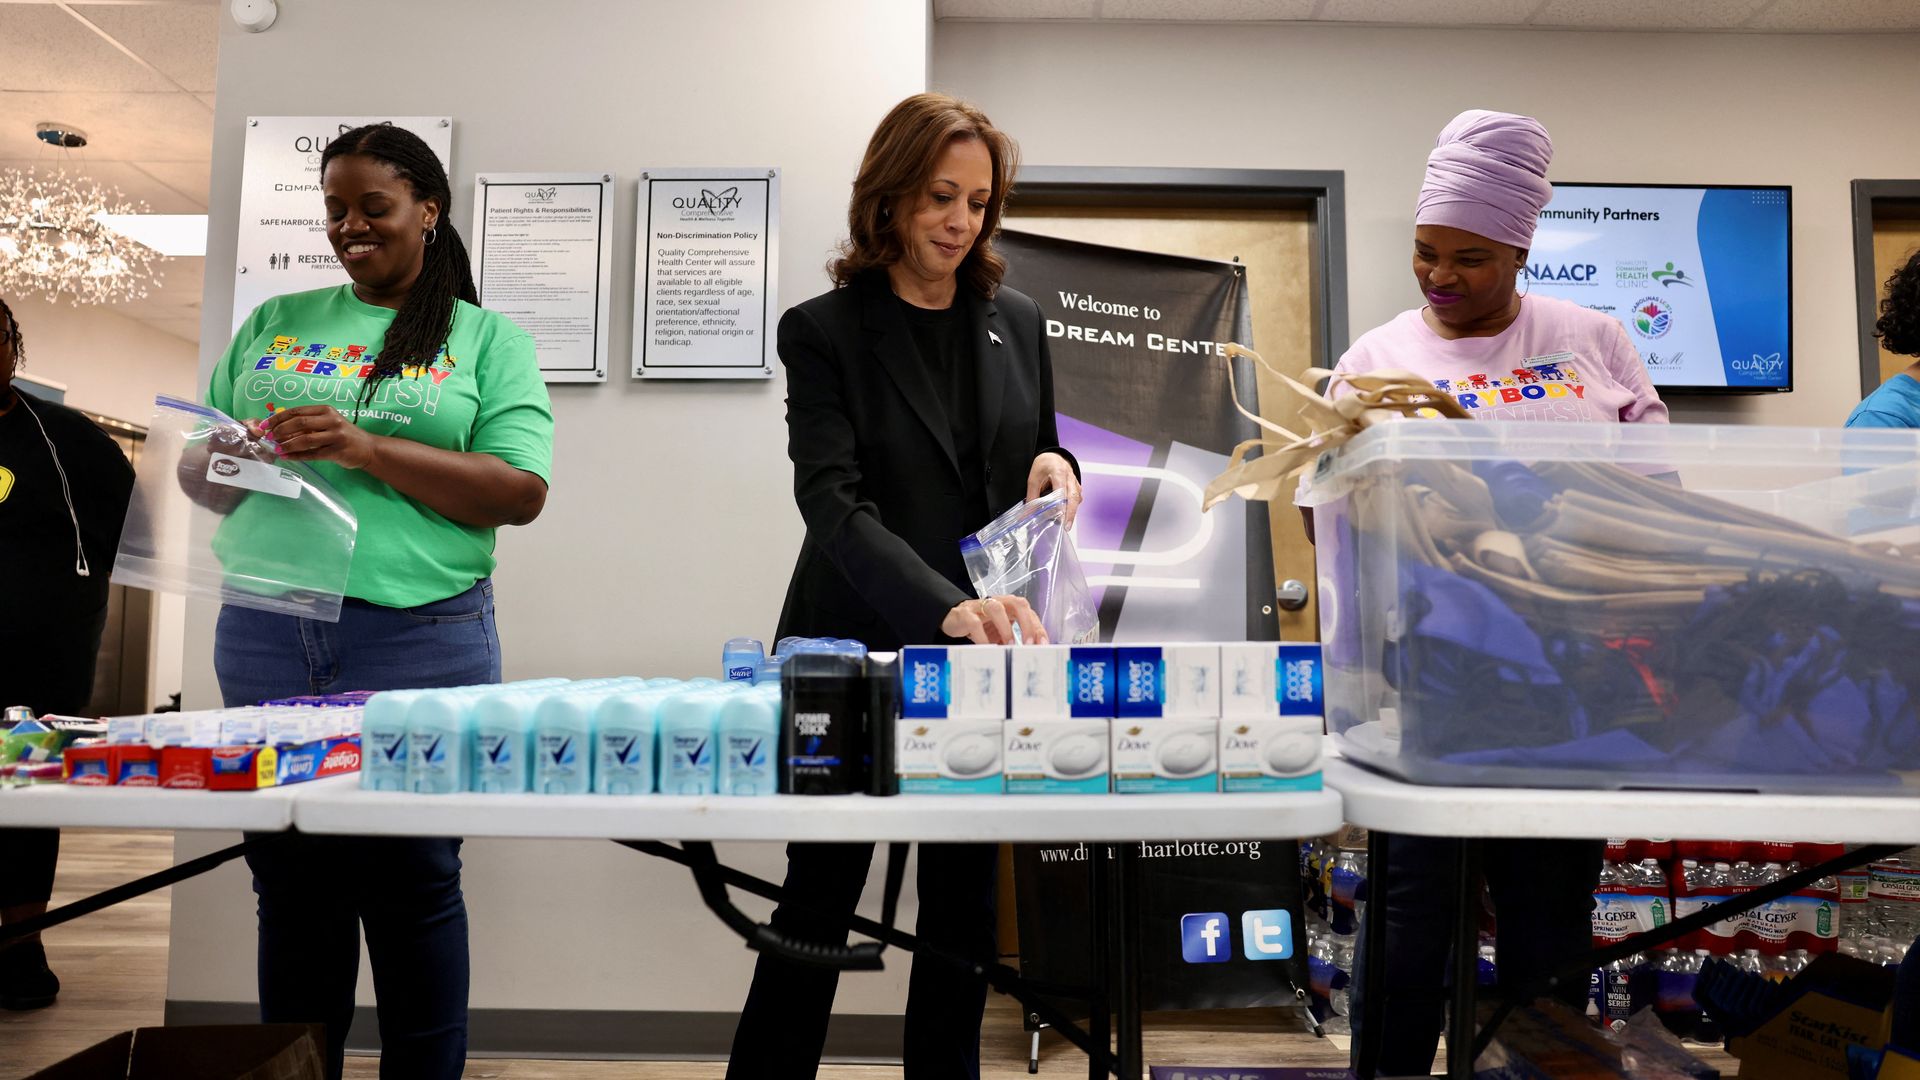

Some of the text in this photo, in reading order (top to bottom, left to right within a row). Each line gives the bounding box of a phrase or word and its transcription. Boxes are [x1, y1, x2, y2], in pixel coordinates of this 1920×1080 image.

[274, 183, 324, 192] COMPA
[525, 190, 558, 199] QUALITY
[672, 197, 742, 209] QUALITY
[1540, 207, 1660, 224] mmunity Partners
[733, 232, 758, 240] Policy
[298, 255, 339, 263] RESTRO
[658, 249, 750, 257] Quality Comprehensive
[1525, 263, 1597, 281] NAACP
[656, 278, 692, 286] available
[703, 278, 713, 286] all
[714, 278, 743, 287] eligible
[1616, 280, 1648, 288] CLINIC
[656, 288, 682, 296] clients
[683, 288, 725, 297] regardless
[727, 288, 735, 296] of
[656, 299, 676, 307] race,
[1058, 291, 1161, 320] Welcome to
[655, 308, 740, 316] orientation/affectional
[655, 318, 737, 327] preference, ethnicity,
[655, 328, 686, 338] religion,
[688, 328, 720, 336] national
[721, 328, 744, 337] origin
[1046, 319, 1245, 357] DREAM CENTE
[654, 338, 693, 348] handicap.
[1731, 359, 1784, 370] QUALITY
[1455, 383, 1586, 410] RYBODY
[351, 409, 412, 425] COALITION
[730, 669, 752, 677] Suave
[911, 660, 927, 704] lever
[926, 663, 940, 702] 2000
[1078, 663, 1092, 702] 2000
[1091, 661, 1106, 704] lever
[1127, 660, 1142, 703] lever
[1141, 661, 1155, 701] 2000
[1286, 661, 1299, 700] 2000
[1298, 659, 1314, 702] lever
[794, 712, 832, 725] POWER
[904, 738, 937, 751] Dove
[1009, 738, 1042, 751] Dove
[1117, 737, 1151, 751] Dove
[1225, 737, 1259, 750] Dove
[323, 751, 360, 769] Colgate
[1605, 911, 1637, 922] GEYSER
[1765, 911, 1798, 924] GEYSER
[1747, 919, 1777, 928] NATURAL
[1751, 923, 1773, 933] SPRING
[1200, 917, 1283, 956] f t
[1612, 986, 1627, 994] WIN
[1607, 1000, 1631, 1008] SERIES
